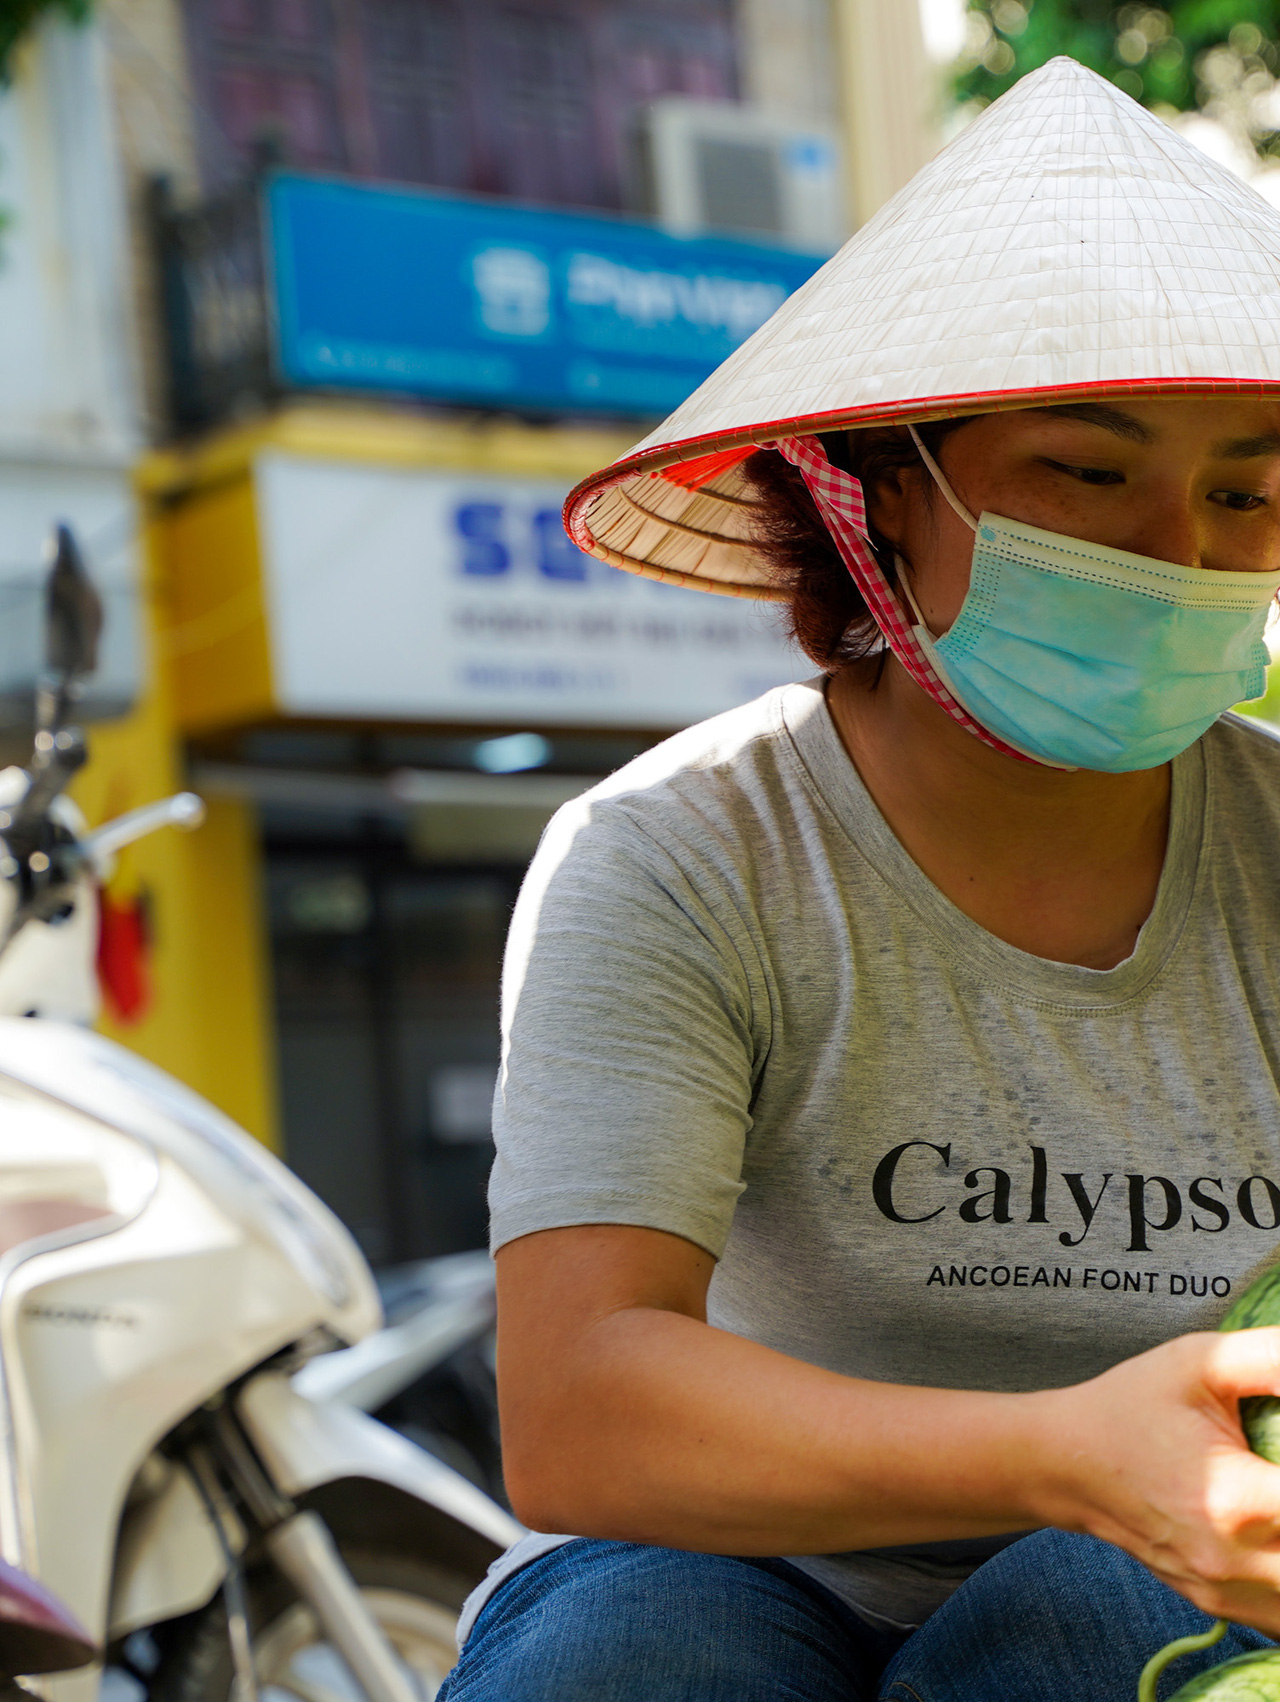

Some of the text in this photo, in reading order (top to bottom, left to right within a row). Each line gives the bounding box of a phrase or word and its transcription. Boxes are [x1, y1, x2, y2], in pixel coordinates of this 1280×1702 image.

[926, 1264, 1232, 1298] ANCOEAN FONT DUO
